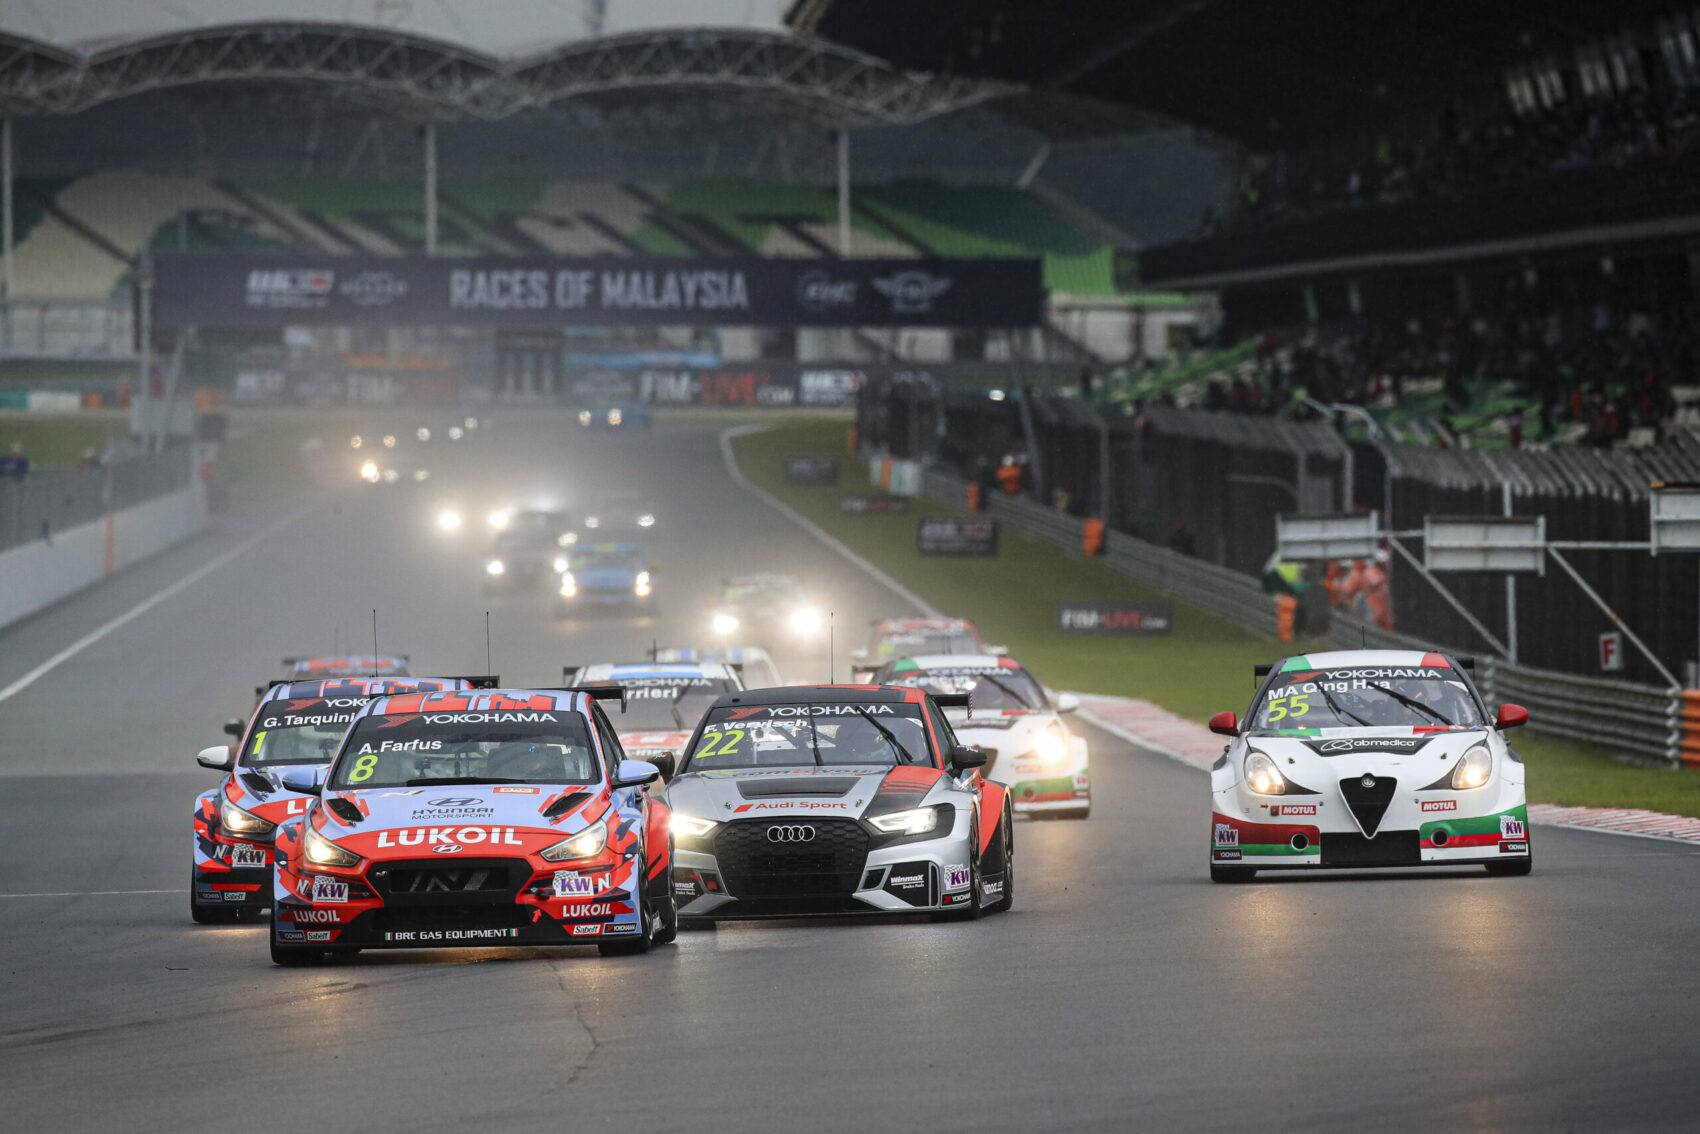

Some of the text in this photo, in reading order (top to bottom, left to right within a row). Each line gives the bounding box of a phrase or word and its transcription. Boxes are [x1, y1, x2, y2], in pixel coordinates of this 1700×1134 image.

[450, 269, 549, 308] RACES
[556, 270, 594, 308] OF
[602, 270, 749, 309] MALAYSIA
[1603, 638, 1615, 666] F
[1325, 668, 1442, 679] YOKOHAMA
[617, 678, 712, 687] YOKOHAMA
[1268, 686, 1299, 700] MA
[768, 704, 895, 716] YOKOHAMA
[1268, 694, 1310, 722] 55
[423, 713, 558, 725] YOKOHAMA
[252, 731, 267, 754] 1
[695, 729, 745, 759] 22
[1354, 739, 1412, 747] abmedica
[350, 754, 378, 782] 8
[755, 801, 847, 810] Audi Sport
[1282, 806, 1315, 814] MOTUL
[1423, 802, 1455, 811] MOTUL
[1505, 822, 1523, 834] KW
[377, 827, 523, 848] LUKOIL
[1218, 830, 1237, 843] KW
[237, 850, 265, 864] KW
[316, 883, 347, 898] KW
[561, 878, 591, 892] KW
[293, 910, 340, 922] LUKOIL
[563, 903, 613, 918] LUKOIL
[395, 928, 508, 940] BRC GAS EQUIPMENT
